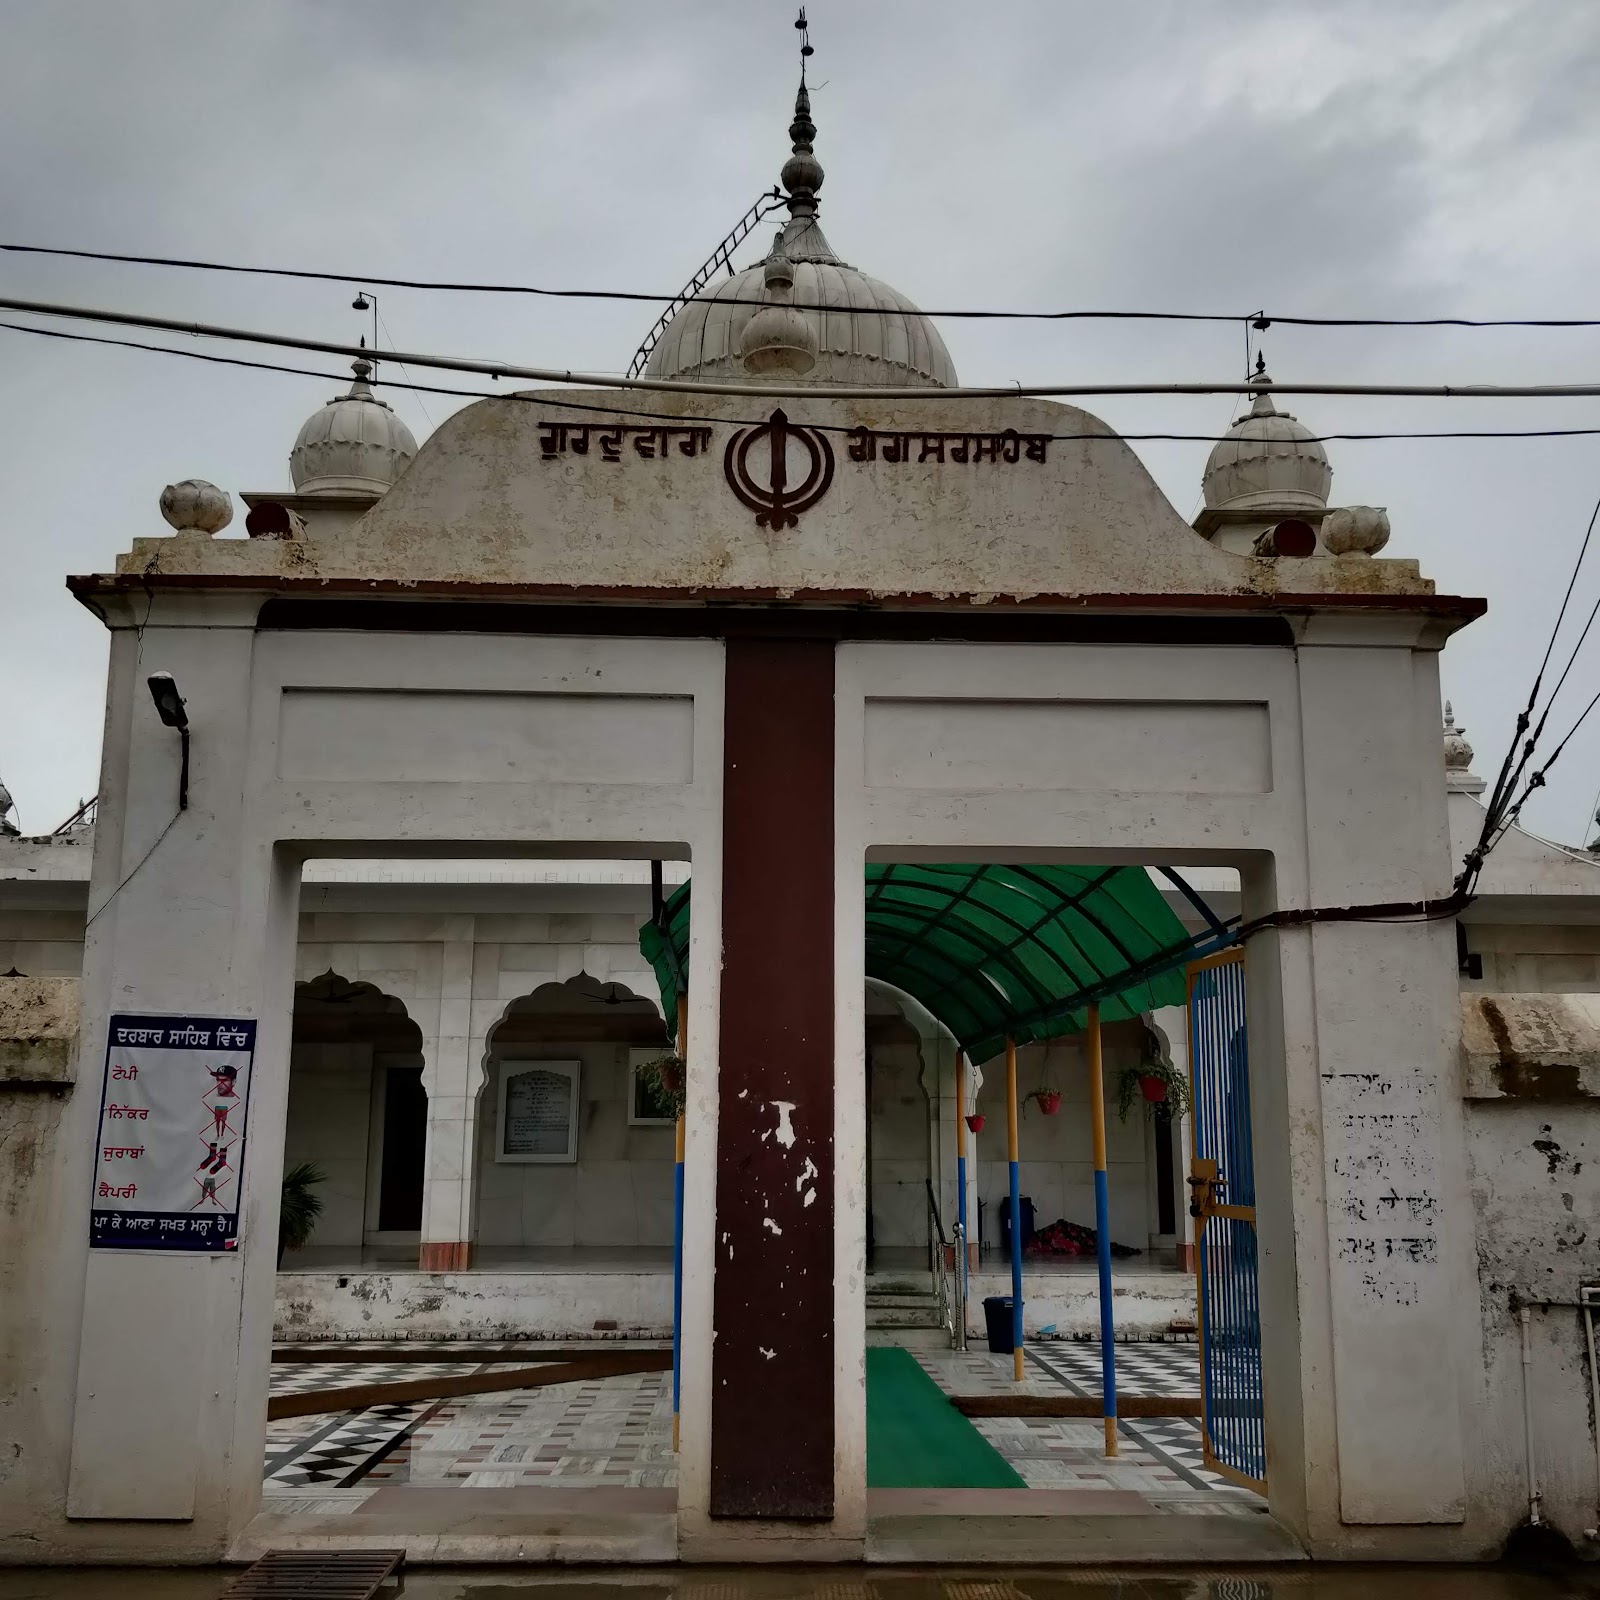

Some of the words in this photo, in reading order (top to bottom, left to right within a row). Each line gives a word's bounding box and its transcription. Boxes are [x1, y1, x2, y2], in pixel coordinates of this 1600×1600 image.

[117, 1027, 164, 1044] ਦਰਬਾਰ
[169, 1025, 211, 1045] ਸਾਹਿਬ
[216, 1026, 248, 1047] ਵਿੱਚ
[112, 1064, 138, 1081] ਟੋਪੀ
[108, 1104, 149, 1121] ਨਿੱਕਰ
[103, 1146, 145, 1162] ਜੁਰਾਬਾਂ
[98, 1181, 137, 1199] ਕੈਪਰੀ
[94, 1216, 108, 1228] ਪਾ
[111, 1213, 122, 1230] ਕੇ
[126, 1217, 155, 1231] ਆਣਾ
